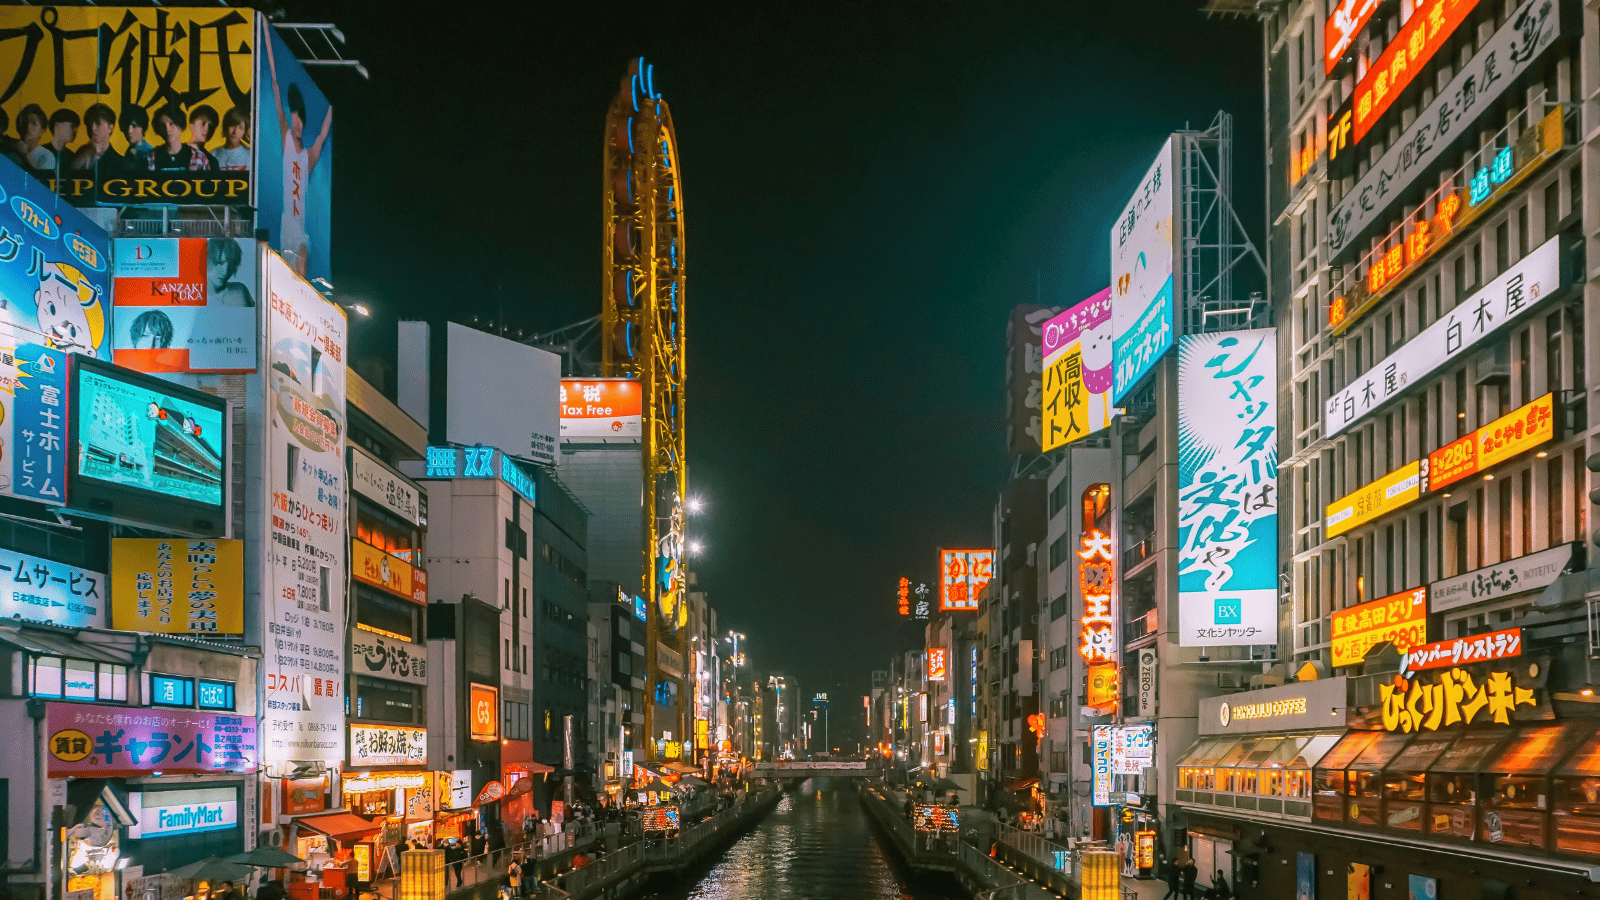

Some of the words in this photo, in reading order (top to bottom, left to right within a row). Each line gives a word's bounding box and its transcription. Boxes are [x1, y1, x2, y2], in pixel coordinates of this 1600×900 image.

[1328, 110, 1351, 161] 7F
[103, 179, 249, 197] GROUP
[21, 201, 50, 235] リフォーム
[151, 281, 203, 296] KANZAKI
[171, 291, 203, 305] RUKA
[1446, 272, 1527, 356] 白木屋
[1046, 359, 1063, 445] バイト
[1064, 352, 1081, 439] 高収入
[1329, 398, 1340, 415] 4F
[1343, 362, 1399, 424] 白木屋
[562, 405, 583, 415] Tax
[587, 405, 612, 415] Free
[39, 384, 60, 498] 富士ホーム
[22, 429, 35, 489] サービス
[948, 556, 993, 579] かに
[1523, 562, 1559, 580] BOTEJYU
[136, 572, 153, 618] 応援します
[157, 542, 173, 624] あなたのお店づくり
[187, 541, 218, 632] 素晴らしい夢の実現
[1218, 605, 1238, 617] BX
[1334, 597, 1413, 637] 豊後高田どり
[1413, 589, 1426, 606] 2F
[1196, 627, 1262, 639] 文化シャッター
[365, 638, 410, 678] うなぎ
[1408, 634, 1519, 665] ハンバーグレストラン
[163, 681, 174, 701] 酒
[200, 686, 224, 705] たばこ
[268, 672, 301, 694] コスパ
[313, 677, 340, 698] 最高!
[477, 701, 490, 724] G3
[1233, 702, 1272, 719] HONOLULU
[1273, 697, 1306, 716] COFFEE
[1379, 667, 1537, 733] びっくりドンキー
[55, 737, 87, 755] 賃貸
[94, 728, 212, 765] ギャラント
[369, 729, 406, 755] お好み焼
[1124, 759, 1140, 772] 免税
[158, 805, 223, 828] FamilyMart
